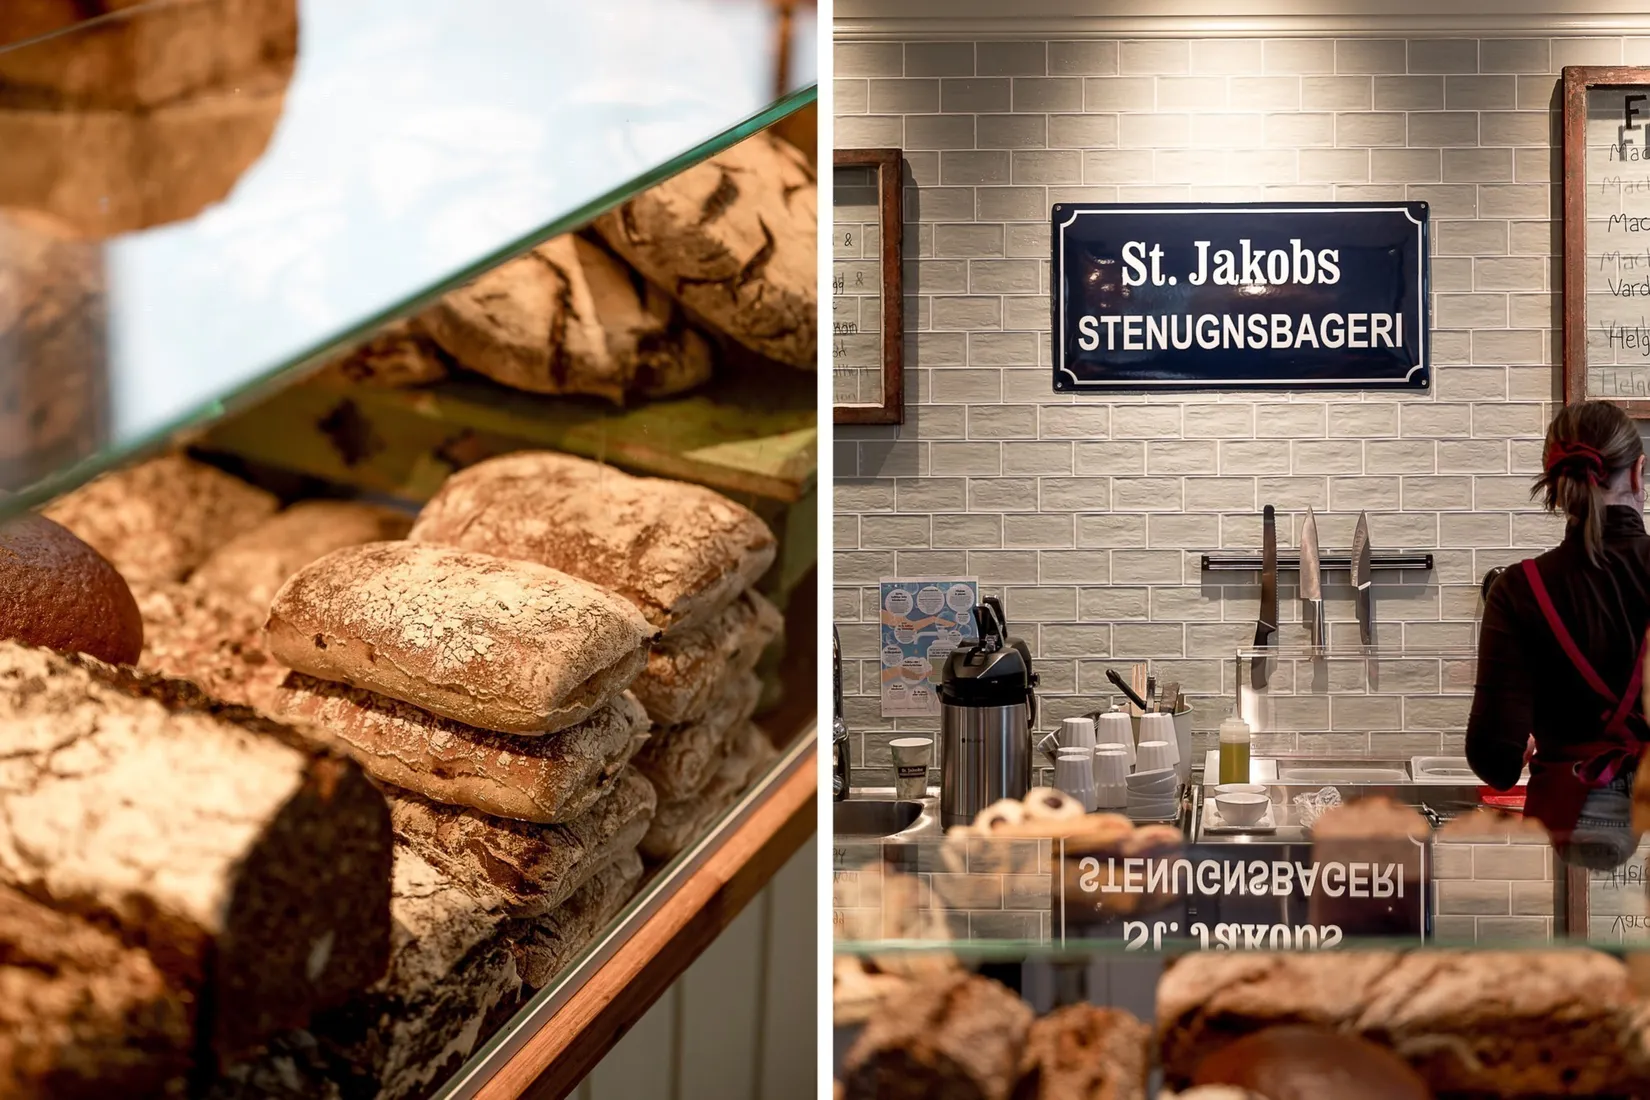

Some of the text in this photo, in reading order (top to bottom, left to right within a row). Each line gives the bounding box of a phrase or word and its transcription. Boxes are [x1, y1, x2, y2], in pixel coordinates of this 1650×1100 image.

[1121, 239, 1341, 287] St. Jakobs
[1078, 312, 1403, 352] STENUGNSBAGERI
